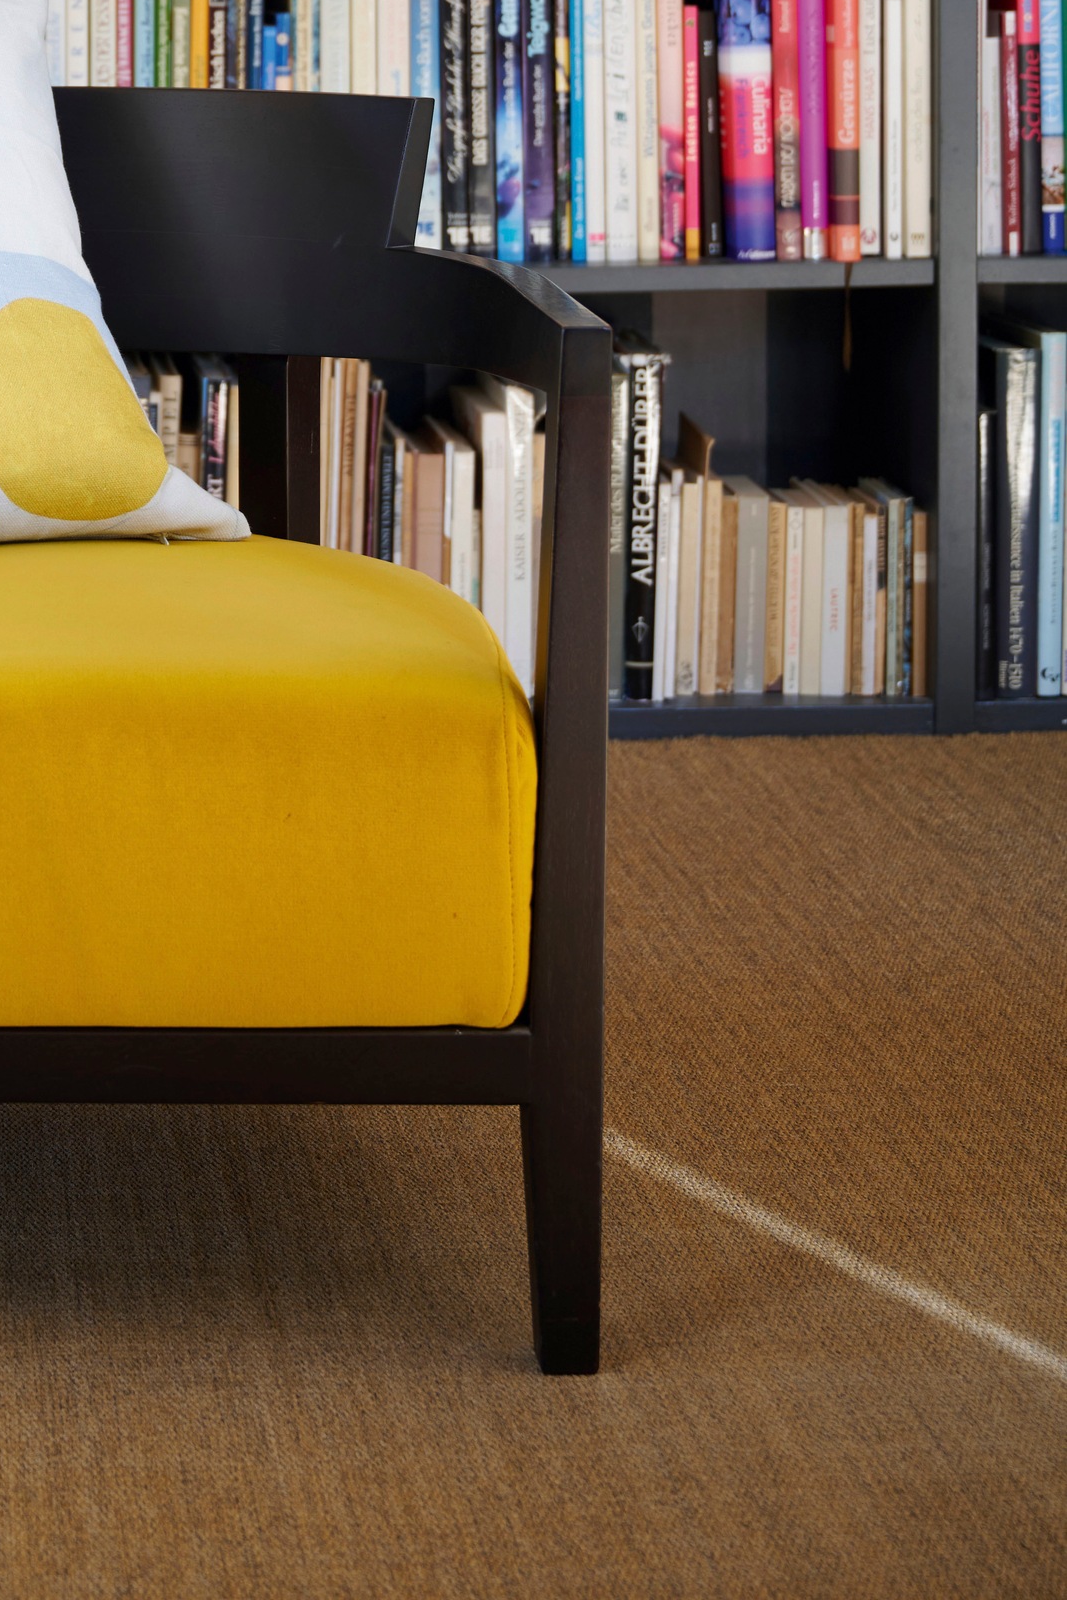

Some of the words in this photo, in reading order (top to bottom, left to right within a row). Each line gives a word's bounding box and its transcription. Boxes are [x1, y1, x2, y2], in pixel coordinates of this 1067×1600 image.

[417, 27, 430, 65] Buch
[686, 61, 696, 108] Basics
[751, 76, 770, 154] Culinaria
[839, 59, 855, 144] Gewürze
[1021, 50, 1041, 142] Schuhe
[686, 116, 697, 161] Indien
[631, 453, 654, 585] ALBRECHT
